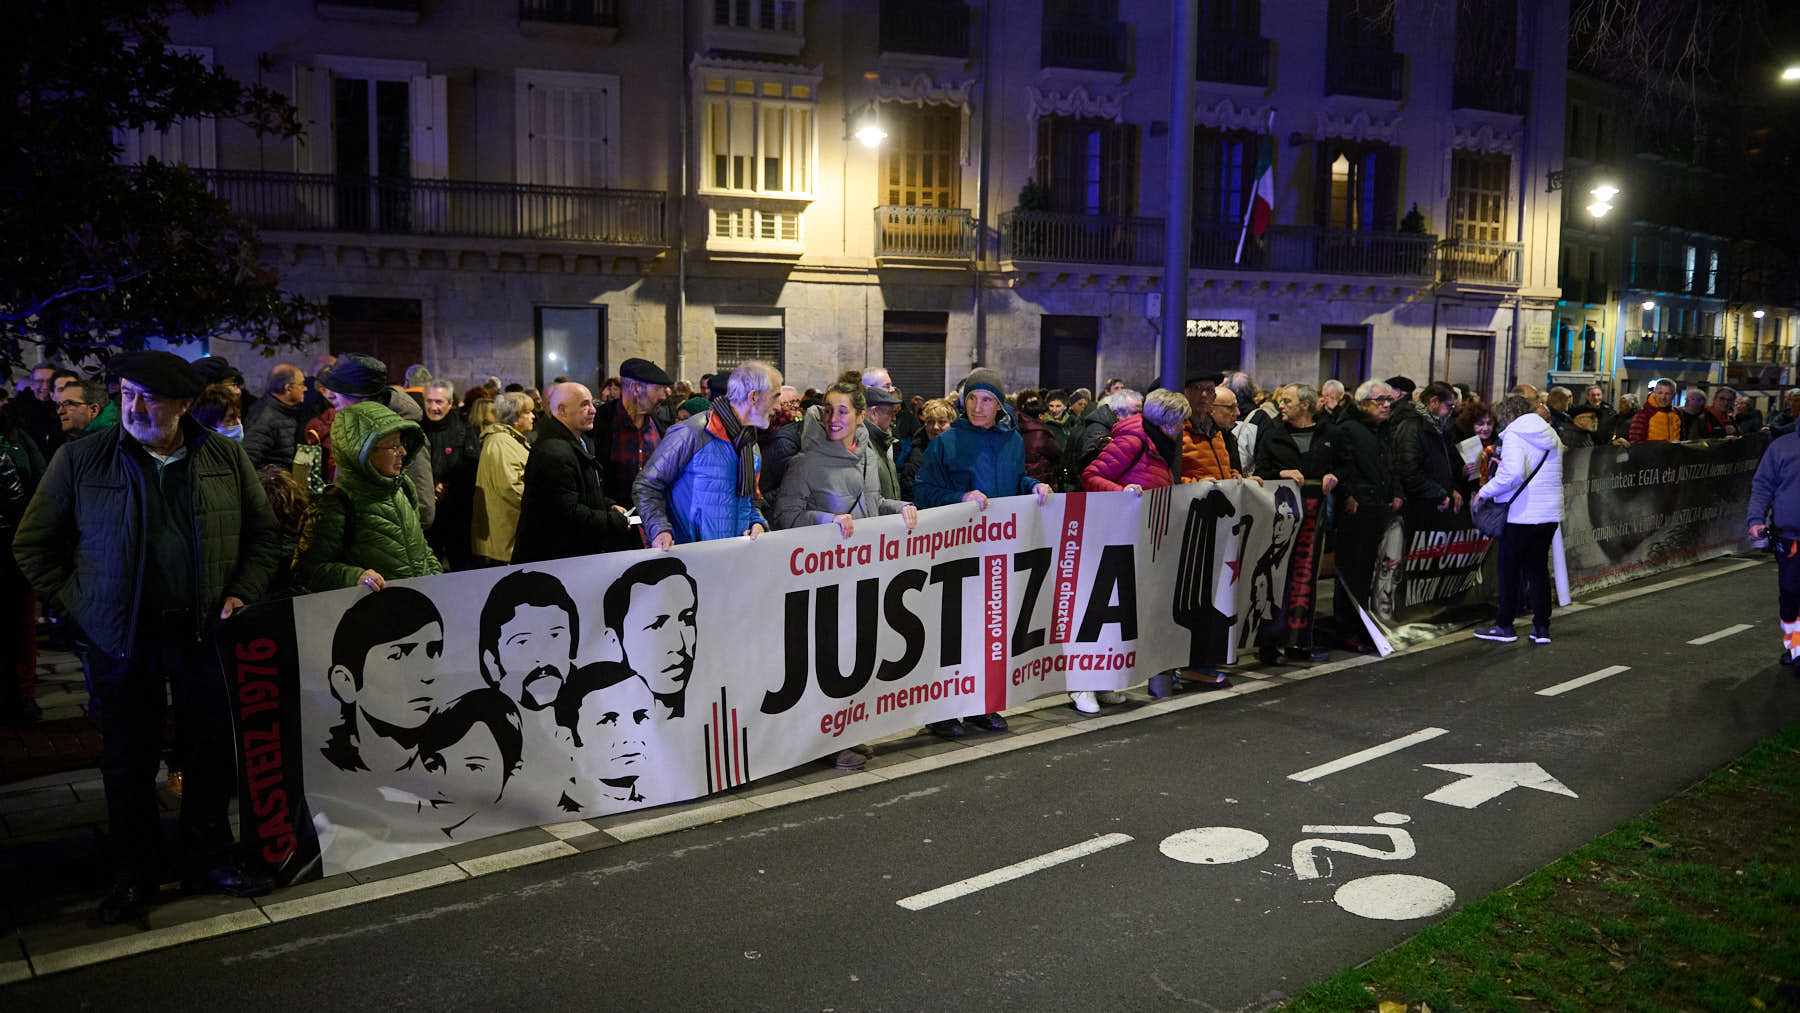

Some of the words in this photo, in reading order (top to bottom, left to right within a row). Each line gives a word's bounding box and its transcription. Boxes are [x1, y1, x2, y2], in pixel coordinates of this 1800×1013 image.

[1638, 468, 1660, 486] EGIA
[1662, 466, 1675, 484] eta
[790, 544, 871, 576] Contra
[879, 533, 899, 561] la
[906, 513, 1017, 559] impunidad
[1068, 520, 1079, 536] ez
[1289, 498, 1319, 611] MARTXOAK
[1060, 541, 1080, 578] dugu
[987, 558, 1002, 636] olvidamos
[1055, 582, 1075, 641] ahazten
[1288, 617, 1308, 630] 3
[235, 638, 280, 720] 1976
[991, 642, 1002, 661] no
[1012, 646, 1137, 686] erreparazioa
[820, 701, 869, 737] egia,
[876, 670, 975, 714] memoria
[243, 722, 298, 864] GASTEIZ
